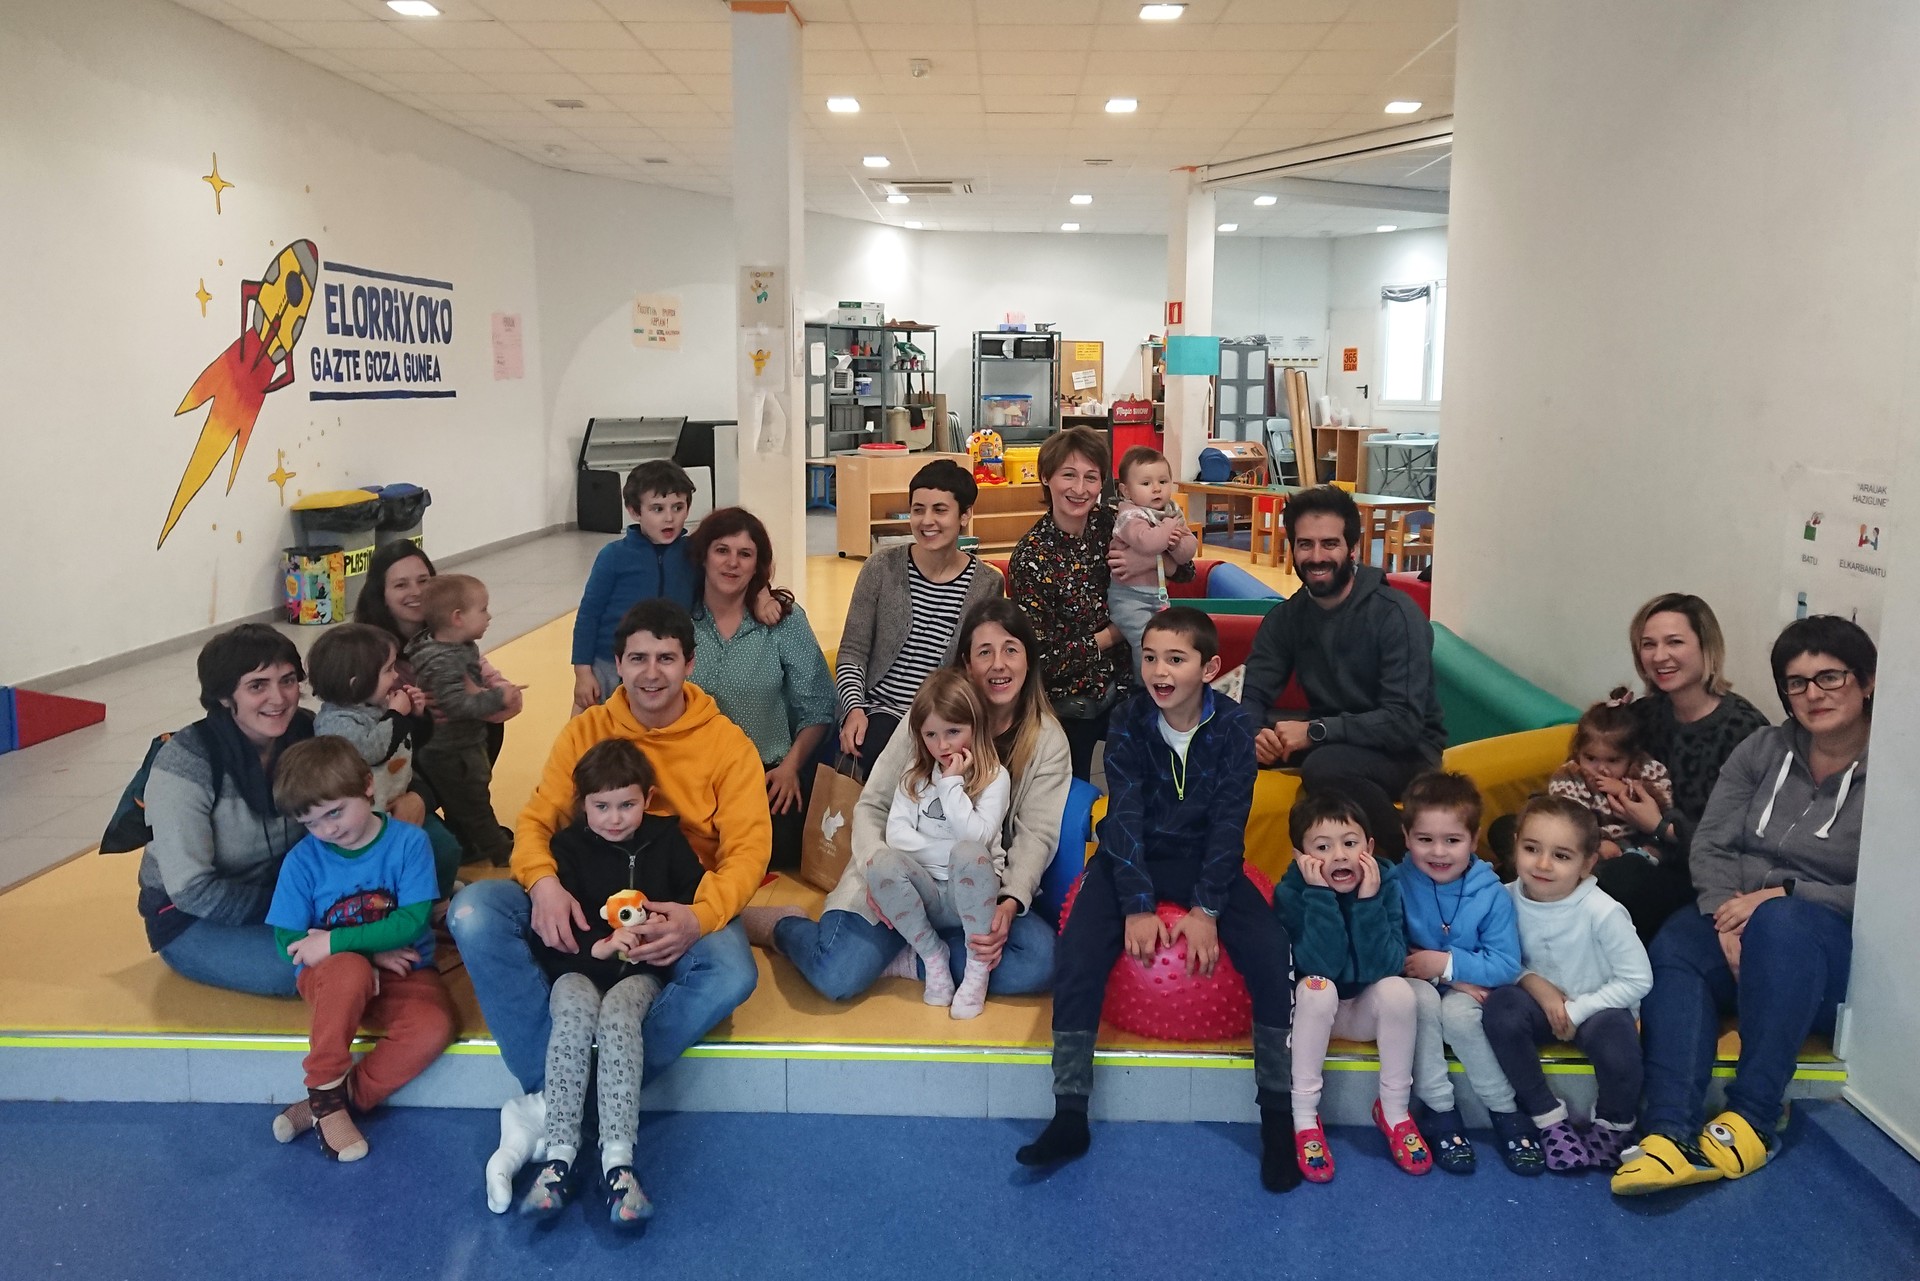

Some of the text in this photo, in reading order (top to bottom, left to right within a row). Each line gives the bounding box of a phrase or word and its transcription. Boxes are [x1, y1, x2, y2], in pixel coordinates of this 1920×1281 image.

[310, 346, 442, 383] GAZTE GOZA GUNEA
[1344, 353, 1357, 363] 365
[1801, 553, 1818, 566] BATU
[1839, 558, 1887, 578] ELKARBANATU
